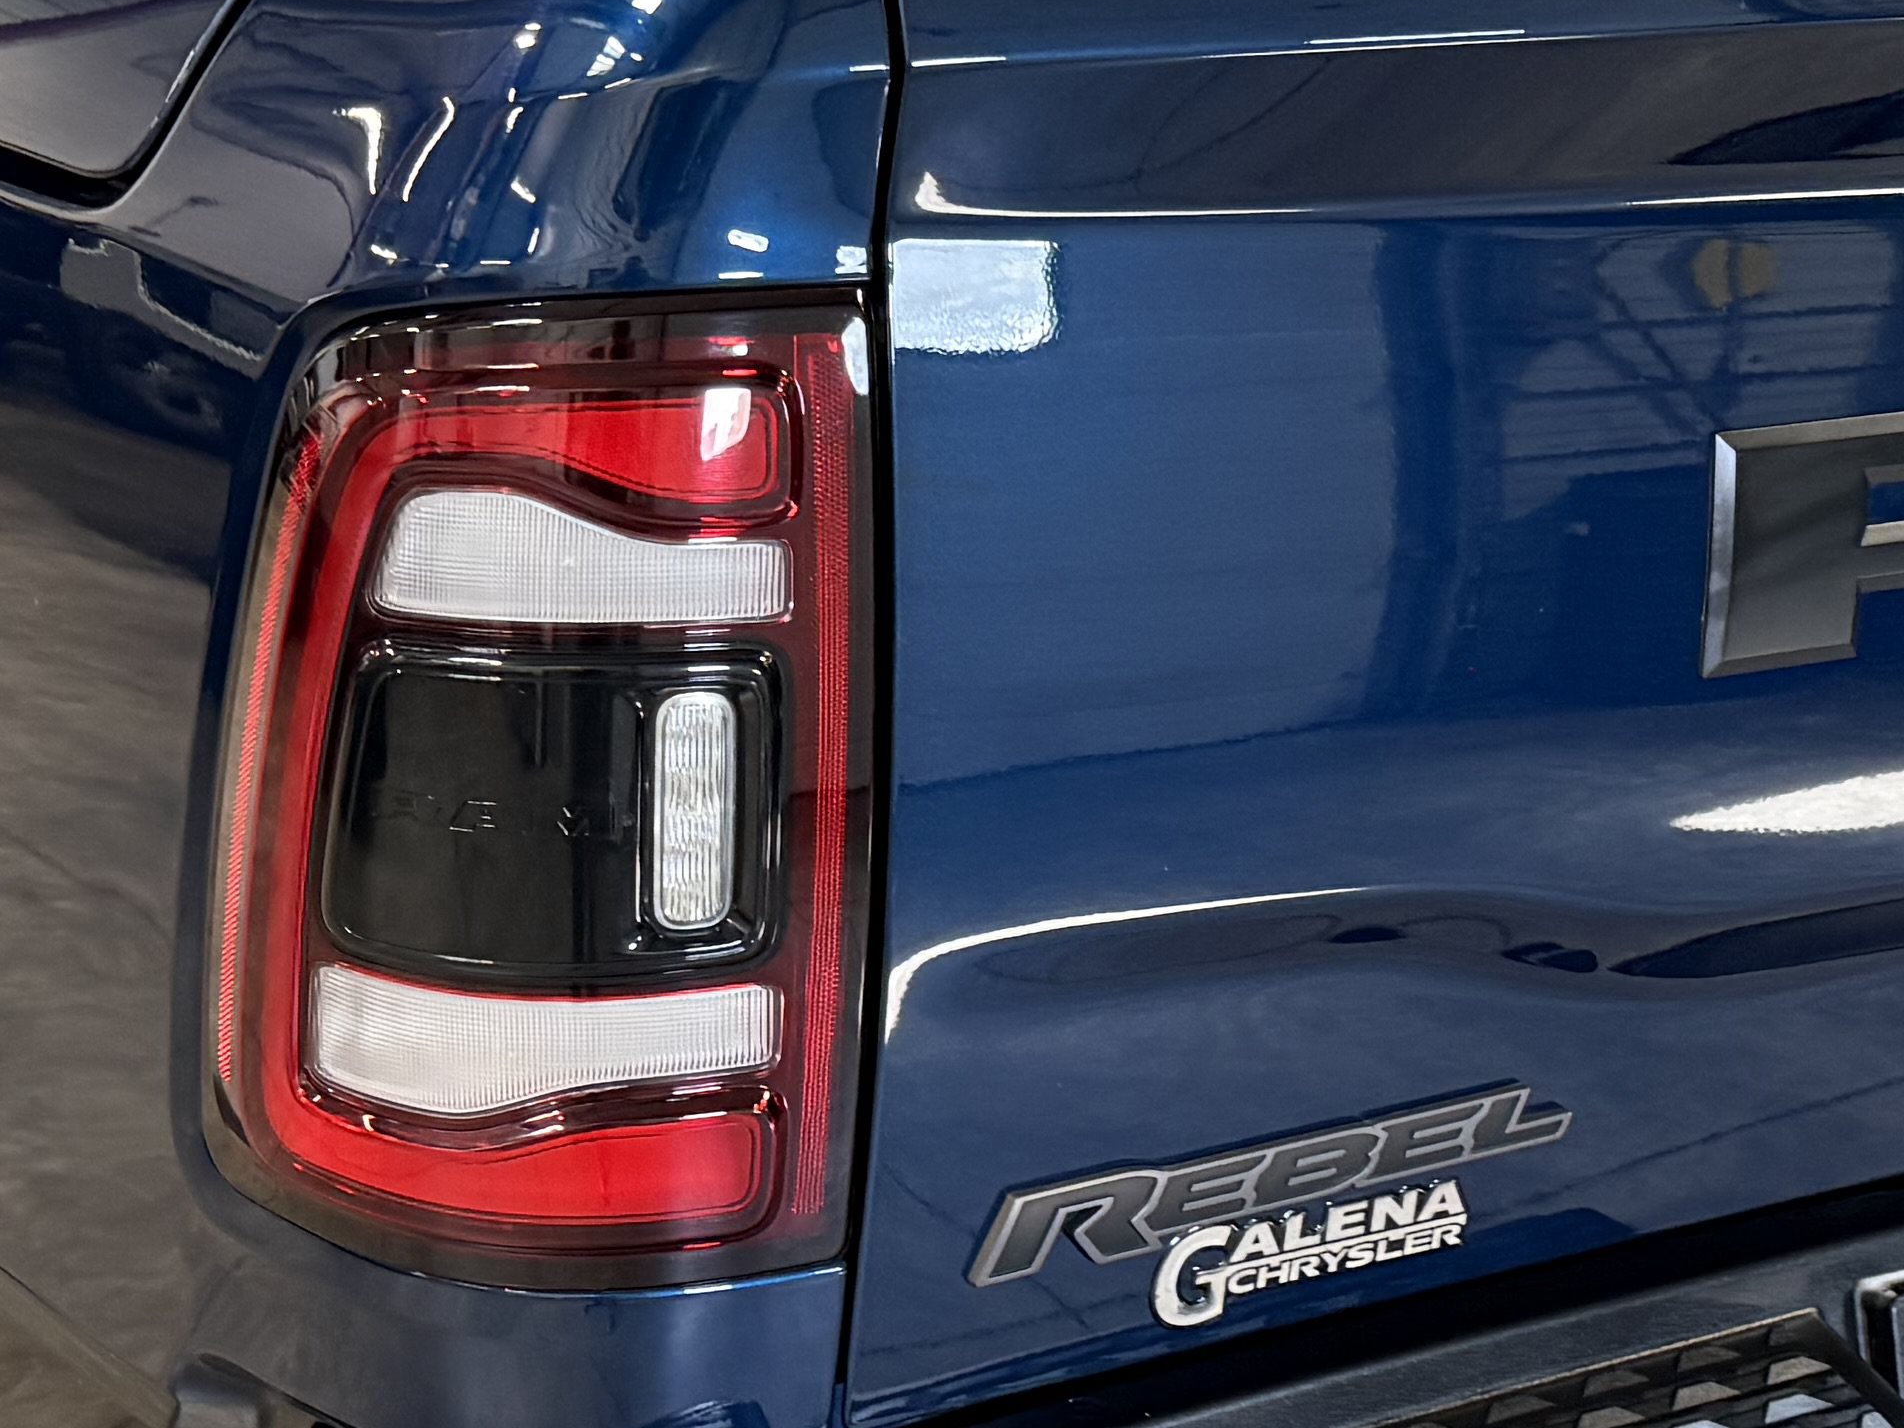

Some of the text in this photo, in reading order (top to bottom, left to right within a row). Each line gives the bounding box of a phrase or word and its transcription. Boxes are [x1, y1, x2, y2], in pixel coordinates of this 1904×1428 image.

[964, 1078, 1574, 1288] REBEL
[1150, 1178, 1469, 1329] GALENA
[1226, 1222, 1464, 1296] CHRYSLER
